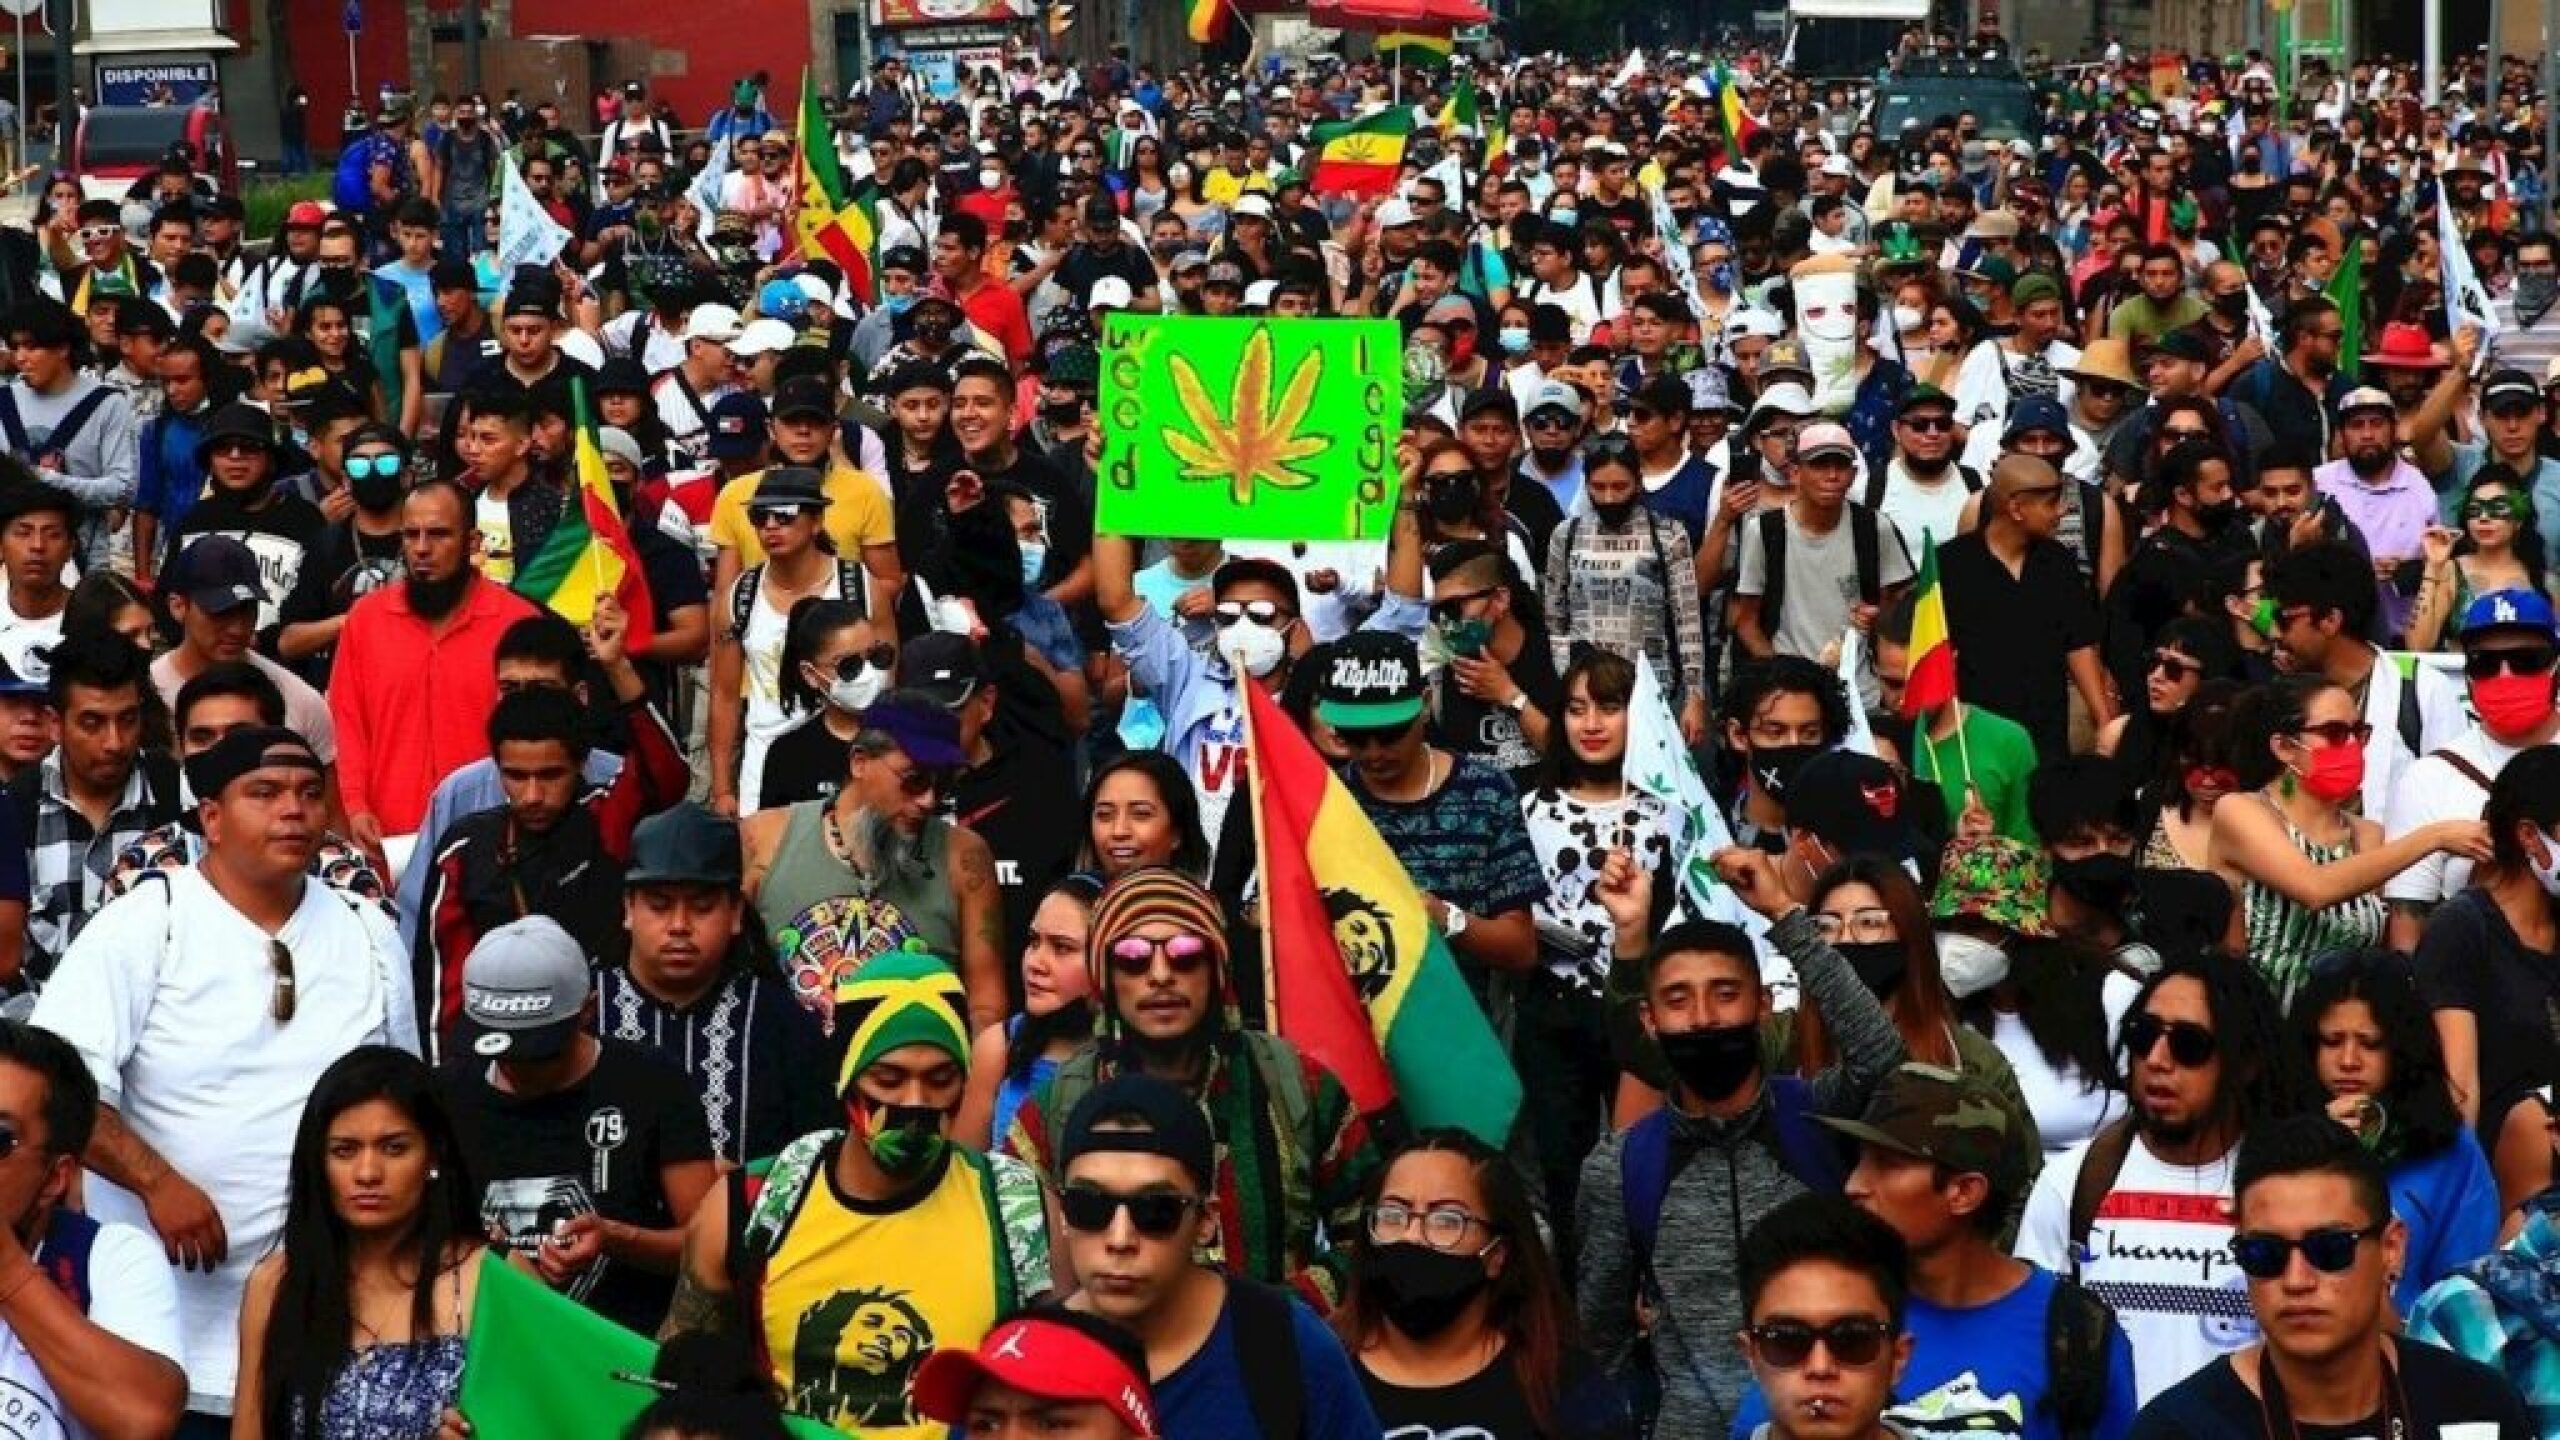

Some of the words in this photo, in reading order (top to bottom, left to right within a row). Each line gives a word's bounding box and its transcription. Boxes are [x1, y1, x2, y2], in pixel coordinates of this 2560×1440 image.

[104, 67, 208, 84] DISPONIBLE
[2495, 596, 2517, 622] LA
[482, 993, 552, 1011] lotto
[590, 1113, 623, 1144] 79
[2080, 1227, 2240, 1281] Champ
